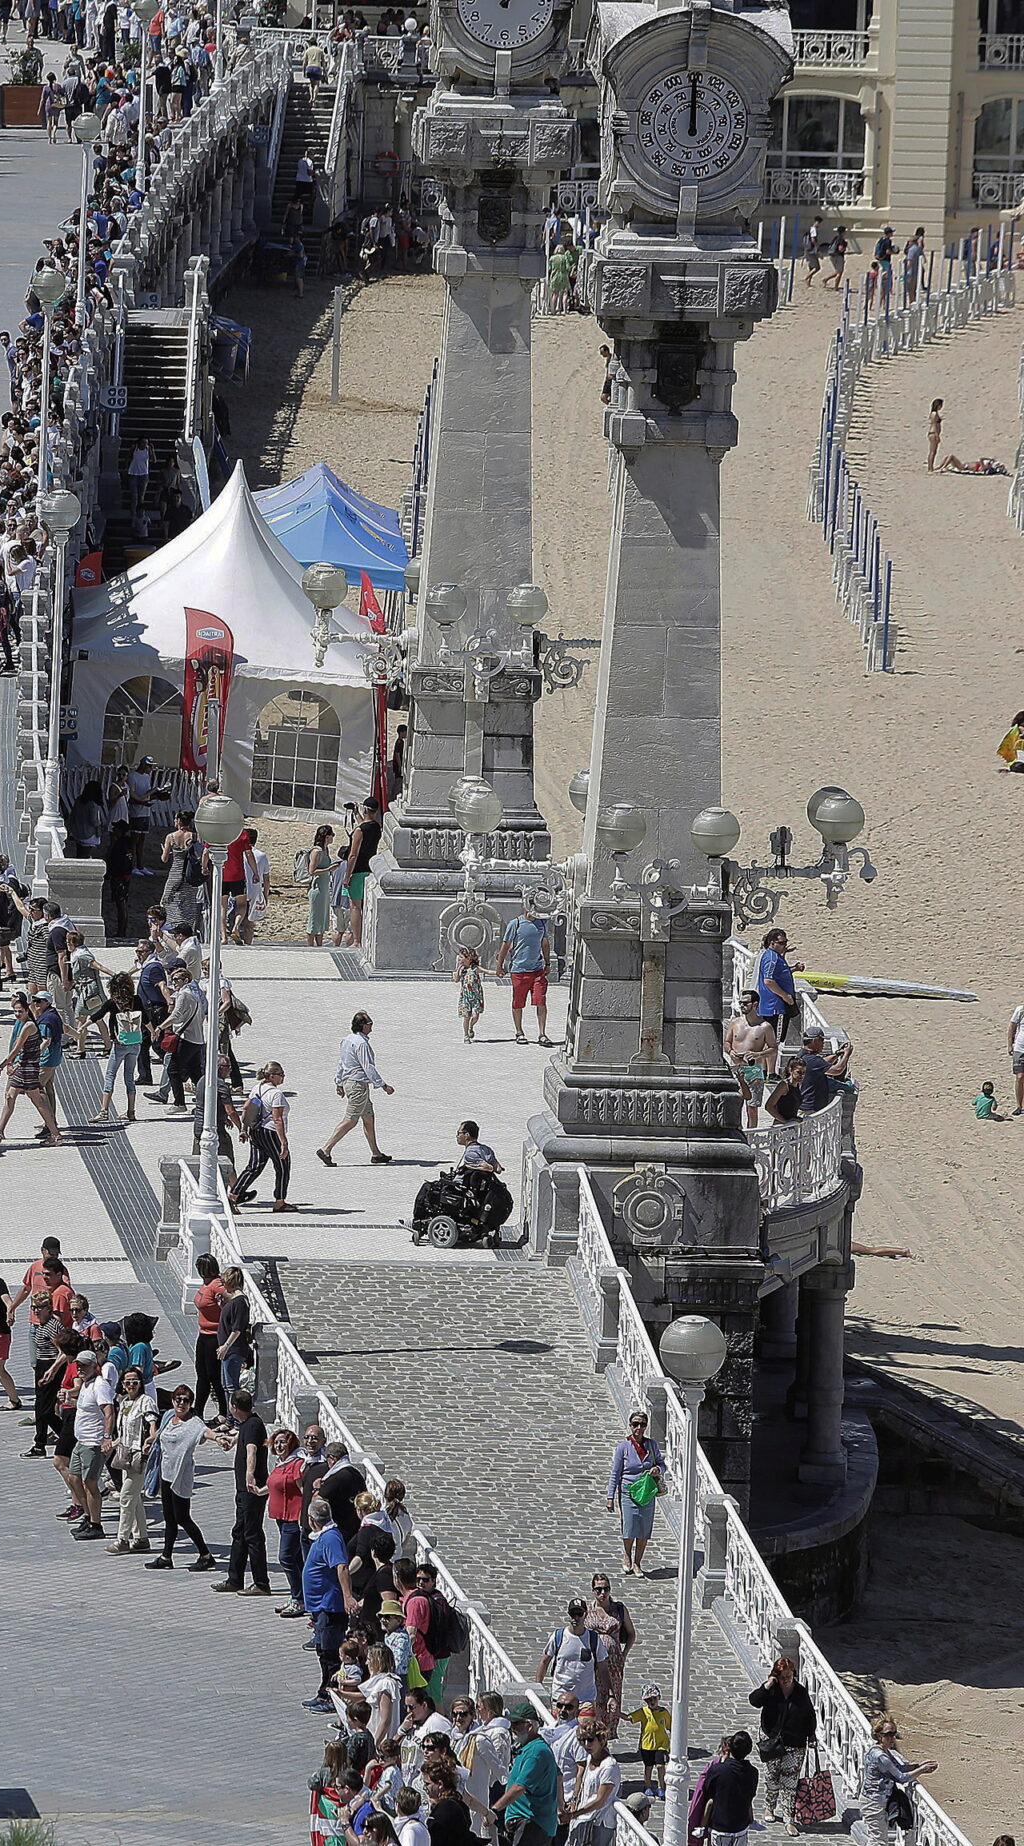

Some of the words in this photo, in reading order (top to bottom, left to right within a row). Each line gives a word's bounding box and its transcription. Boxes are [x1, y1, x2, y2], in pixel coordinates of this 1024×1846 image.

[470, 11, 480, 22] 8
[531, 12, 540, 22] 4
[483, 24, 493, 35] 7
[500, 30, 509, 40] 6
[518, 25, 527, 36] 5
[663, 75, 682, 90] 1000
[707, 75, 725, 92] 1020
[673, 92, 687, 103] 750
[724, 89, 740, 108] 1030
[709, 98, 721, 111] 770
[733, 111, 746, 129] 1040
[670, 163, 686, 177] 950
[692, 163, 710, 177] 1070
